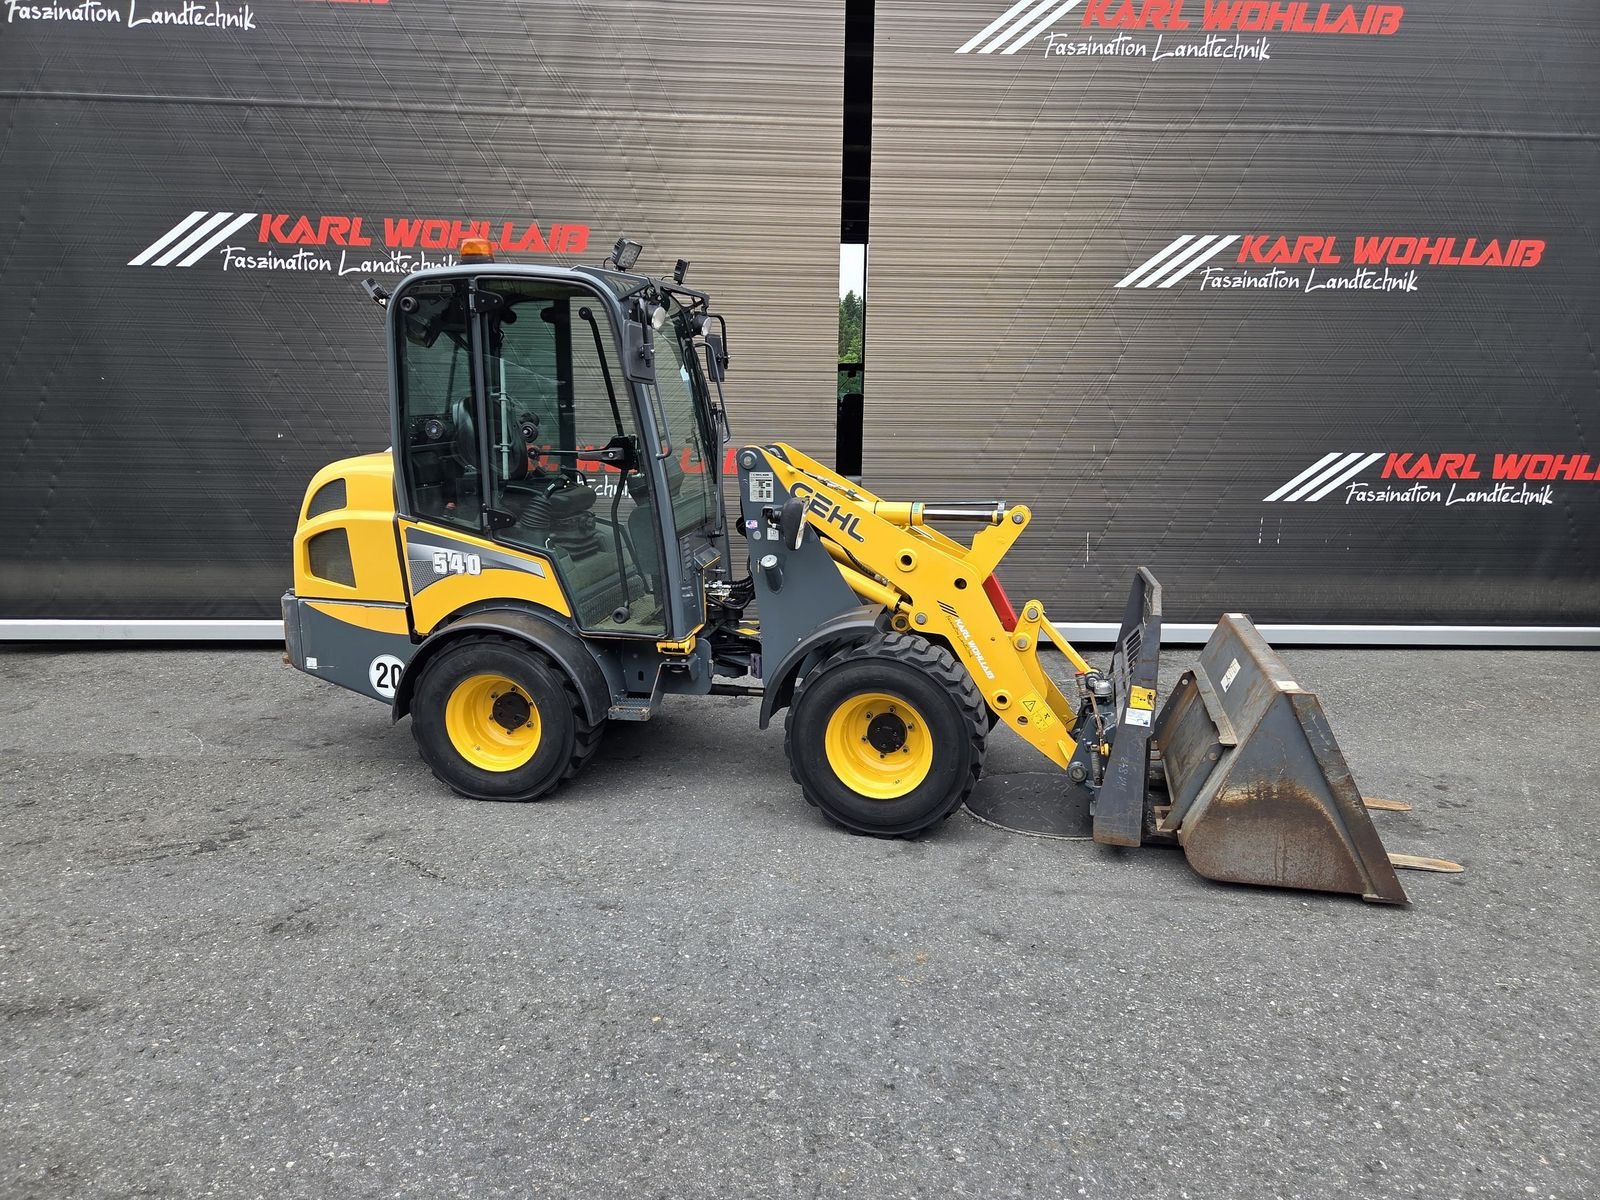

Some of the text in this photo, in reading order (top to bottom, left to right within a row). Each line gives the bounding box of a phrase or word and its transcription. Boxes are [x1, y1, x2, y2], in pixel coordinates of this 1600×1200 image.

[4, 0, 256, 31] Faszination Landtechnik
[1079, 0, 1190, 30] KARL
[1044, 32, 1271, 62] Faszination Landtechnik
[258, 213, 372, 247] KARL
[220, 244, 332, 272] Faszination
[1236, 234, 1341, 265] KARL
[1199, 266, 1418, 293] Faszination Landtechnik
[1380, 452, 1480, 480] KARL
[1345, 481, 1553, 507] Faszination Landtechnik
[433, 552, 483, 576] 540
[375, 661, 403, 690] 20
